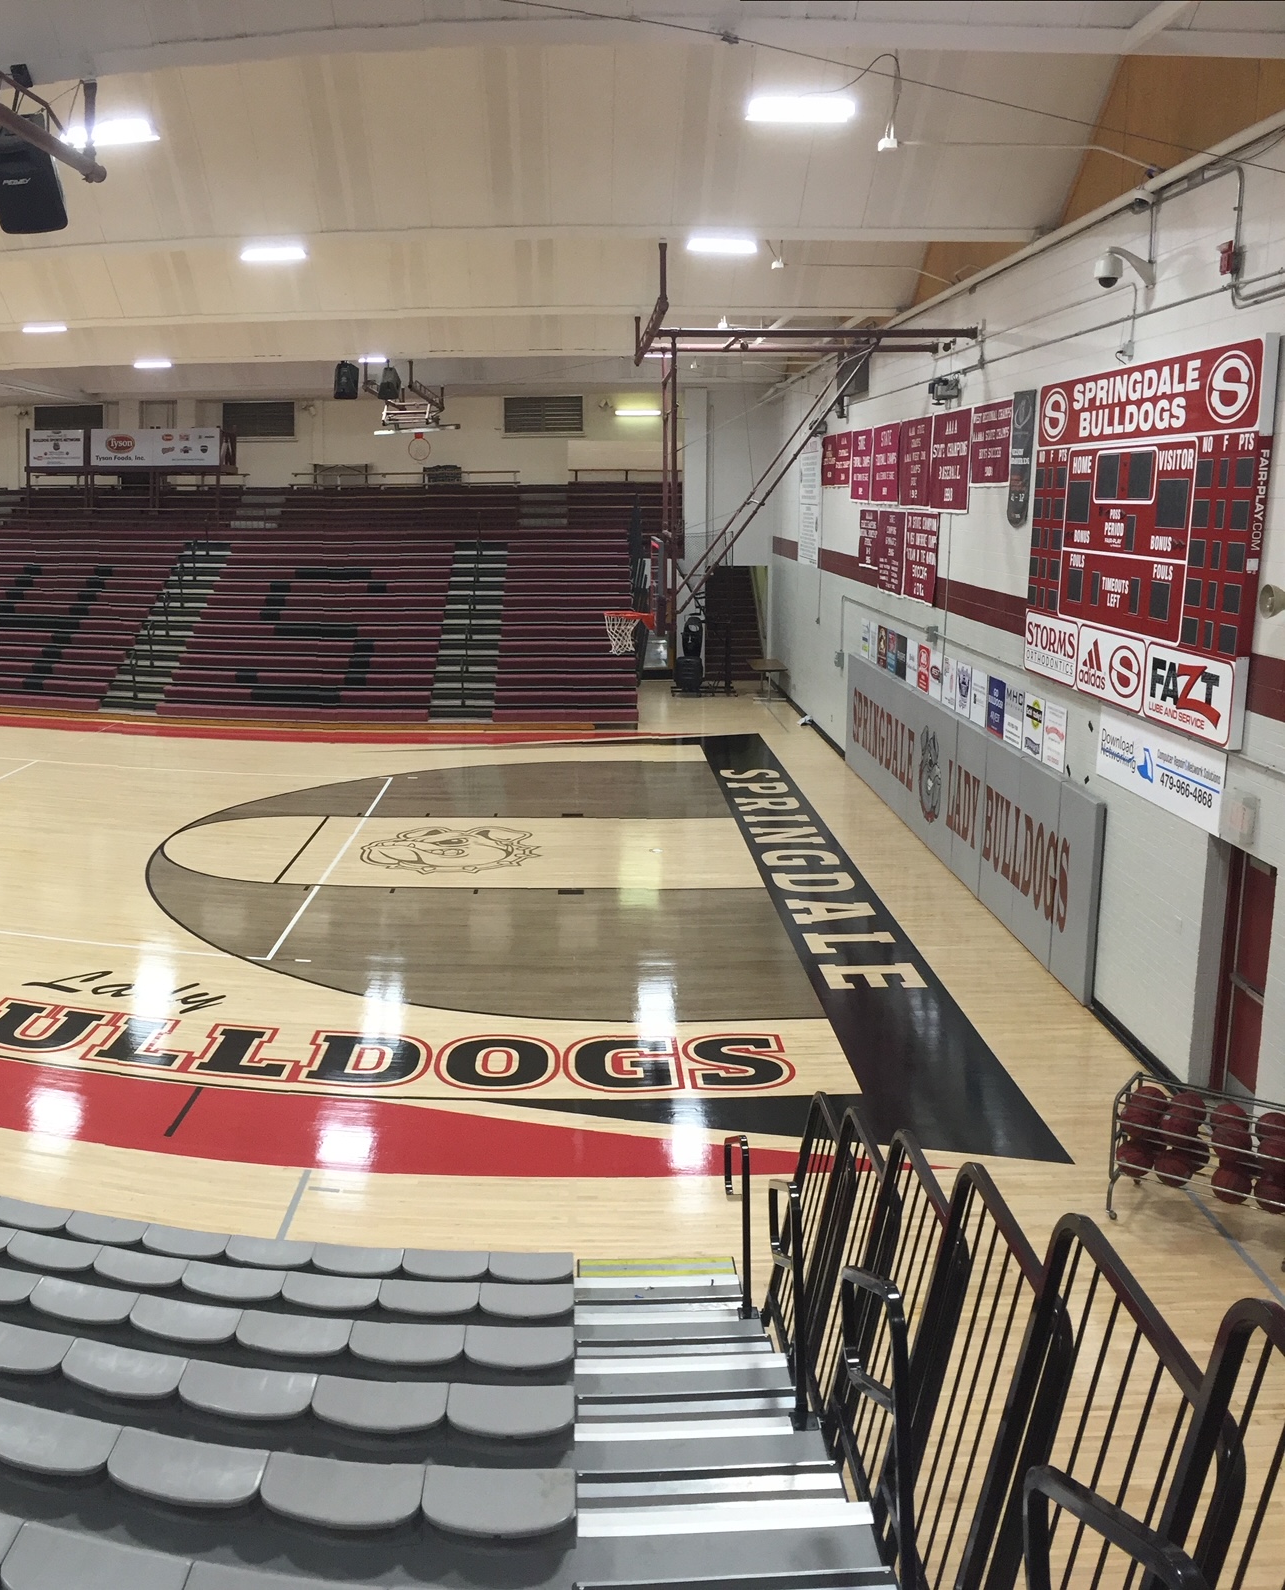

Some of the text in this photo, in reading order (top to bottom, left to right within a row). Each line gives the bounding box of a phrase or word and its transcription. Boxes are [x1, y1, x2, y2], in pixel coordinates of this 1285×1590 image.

[1072, 359, 1202, 411] SPRINGDALE
[1078, 396, 1187, 438] BULLDOGS
[110, 438, 133, 449] Tyson
[1202, 432, 1255, 453] NO F PTS
[1072, 449, 1194, 474] HOME VISITOR
[1250, 449, 1271, 551] FAIR-PLAY.COM
[1109, 509, 1122, 520] POSS
[1073, 529, 1090, 543] BONUS
[1104, 522, 1125, 537] PERIOD
[1150, 535, 1172, 551] BONUS
[1069, 553, 1085, 569] FOULS
[1152, 563, 1174, 581] FOULS
[1102, 576, 1130, 595] TIMEOUTS
[1106, 592, 1121, 609] LEFT
[1027, 621, 1076, 660] STORMS
[1026, 649, 1073, 676] ORTHODONTICS
[1078, 667, 1106, 691] adidas
[1148, 701, 1205, 731] LUBE AND SERVICE
[1101, 728, 1135, 756] Download
[1100, 742, 1137, 774] Networking
[1159, 772, 1213, 809] 479-966-4868
[852, 686, 916, 793] SPRINGDALE
[945, 758, 982, 851] LADY
[981, 783, 1071, 934] BULLDOGS
[717, 768, 929, 991] SPRINGDALE
[22, 970, 227, 1015] Lay
